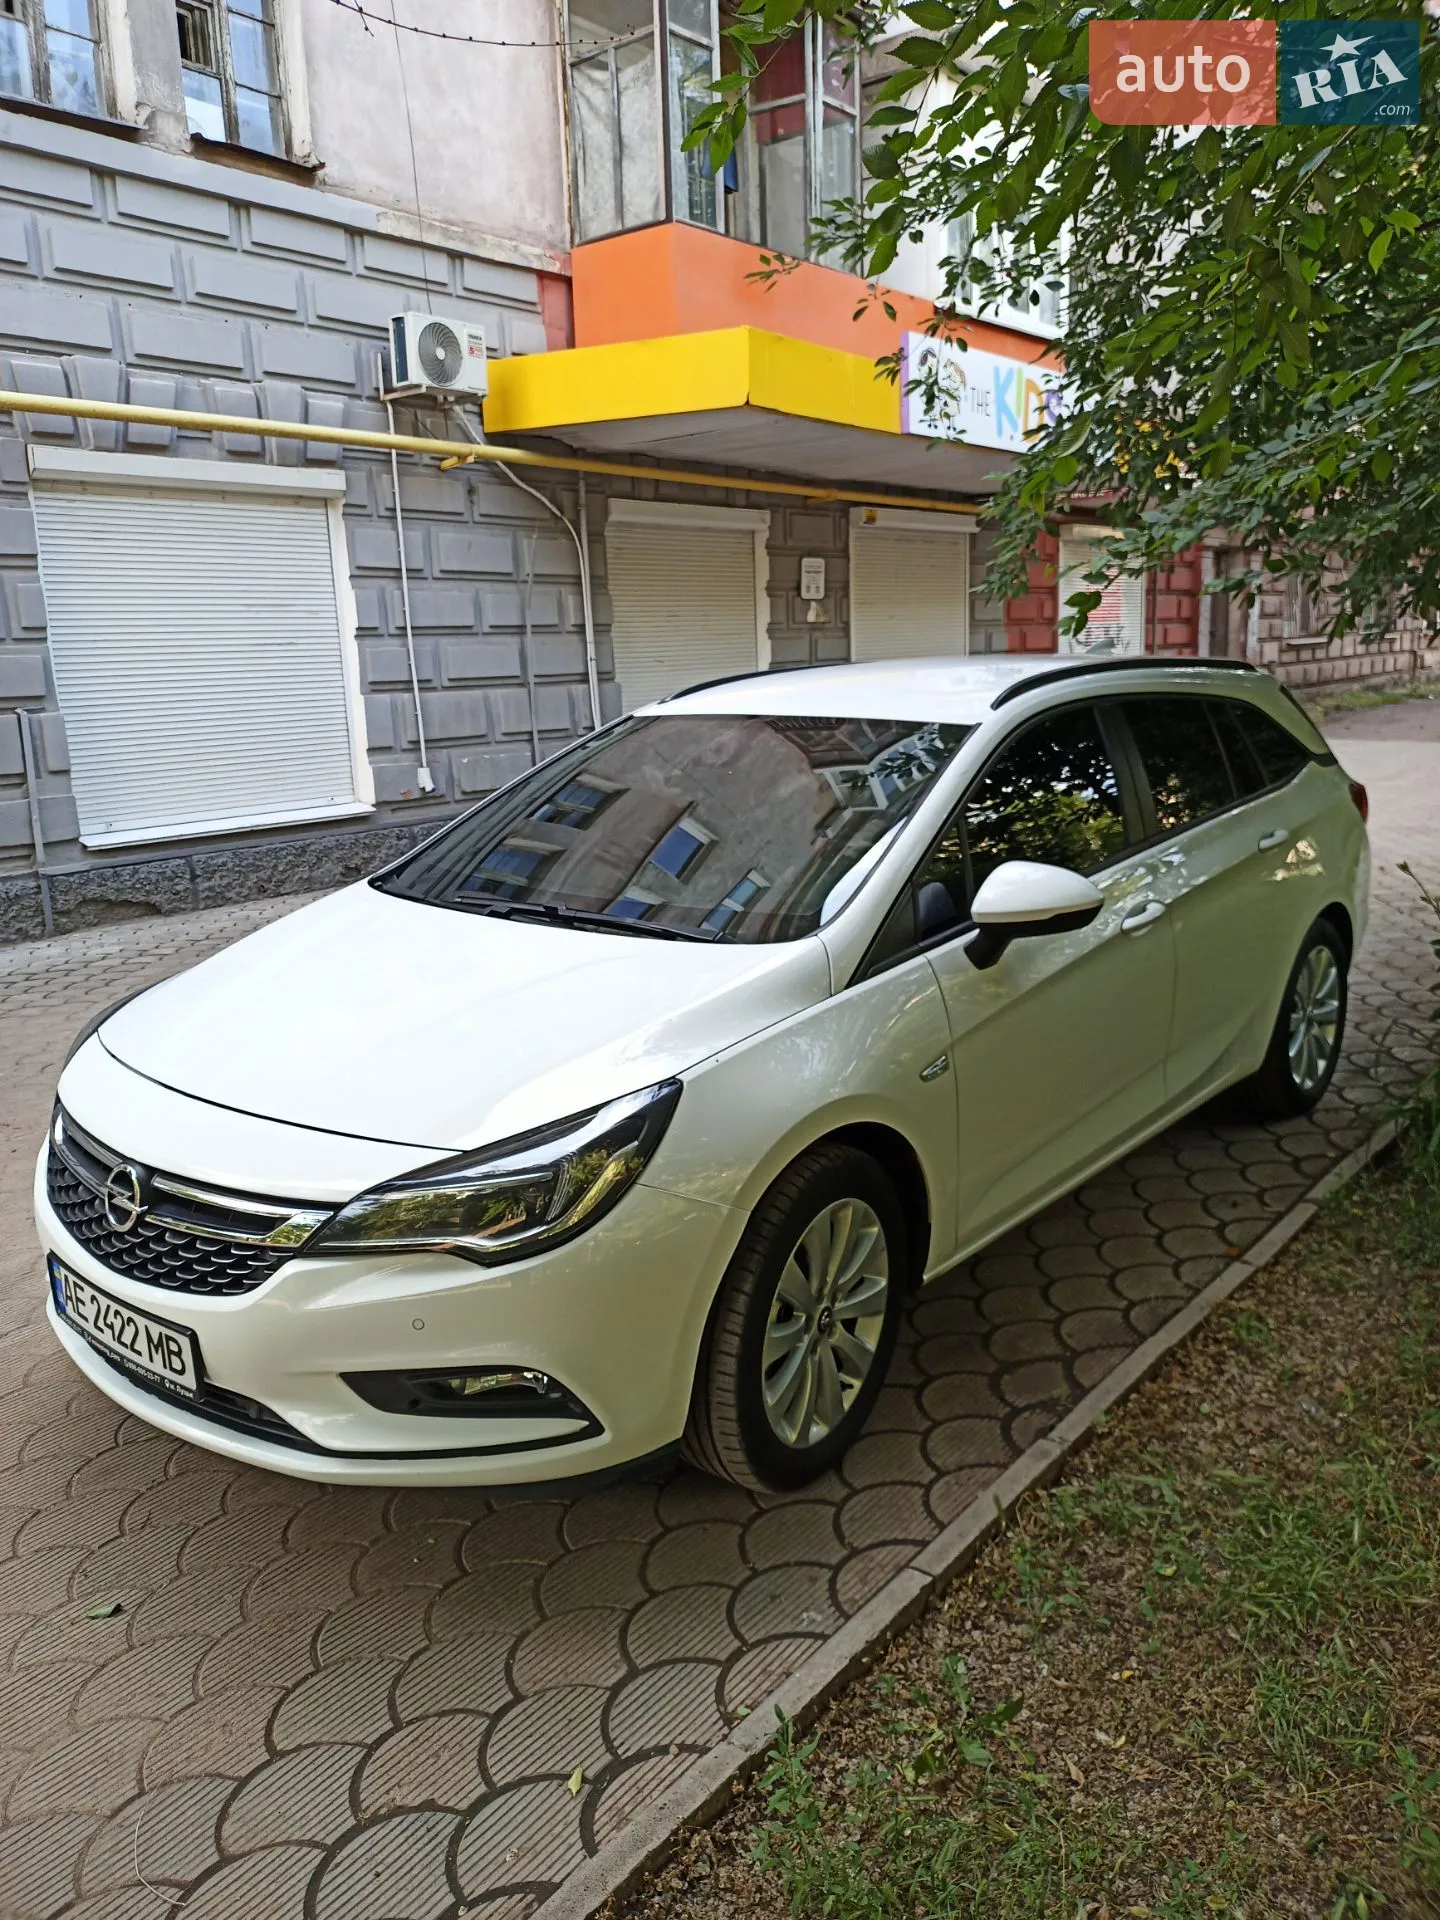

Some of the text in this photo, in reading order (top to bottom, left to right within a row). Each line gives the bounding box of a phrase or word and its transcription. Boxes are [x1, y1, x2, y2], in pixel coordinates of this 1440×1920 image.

[970, 387, 991, 417] THE
[64, 1273, 89, 1323] AE
[90, 1294, 143, 1357] 2422
[145, 1324, 186, 1376] MB
